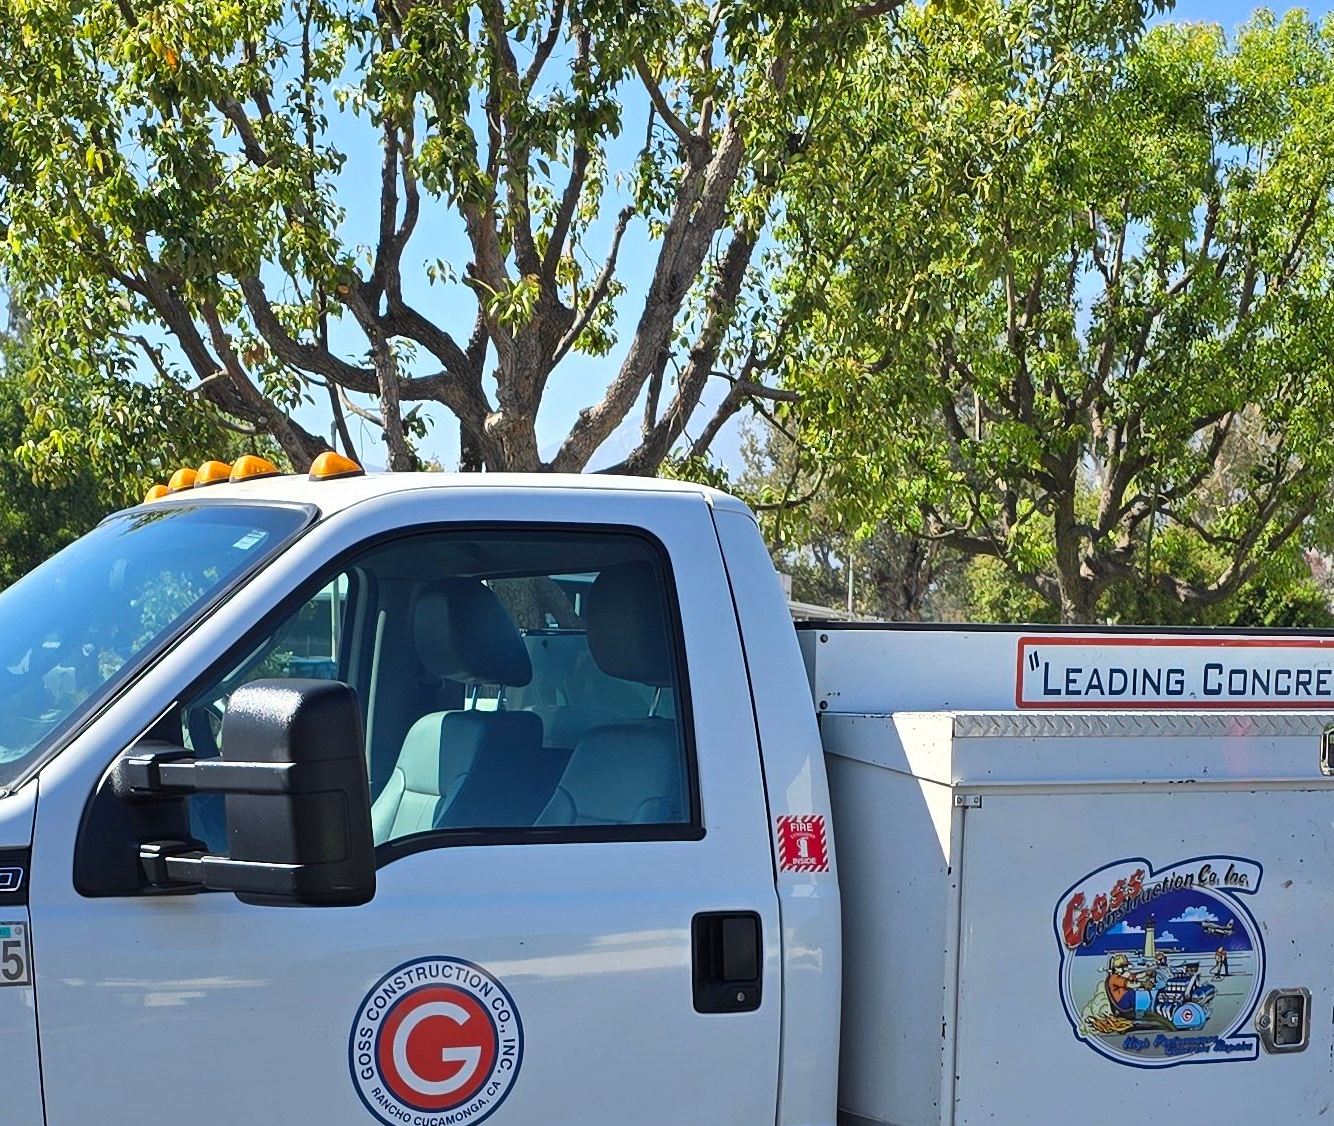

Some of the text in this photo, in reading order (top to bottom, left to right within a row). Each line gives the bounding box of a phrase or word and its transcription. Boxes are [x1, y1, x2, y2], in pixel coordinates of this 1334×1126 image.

[790, 823, 813, 832] FIRE
[358, 1026, 375, 1081] GOSS
[367, 964, 494, 1022] CONSTRUCTION
[497, 1038, 516, 1074] INC.
[393, 1001, 482, 1096] G
[371, 1087, 411, 1123] RANCHO
[487, 1080, 501, 1097] CA
